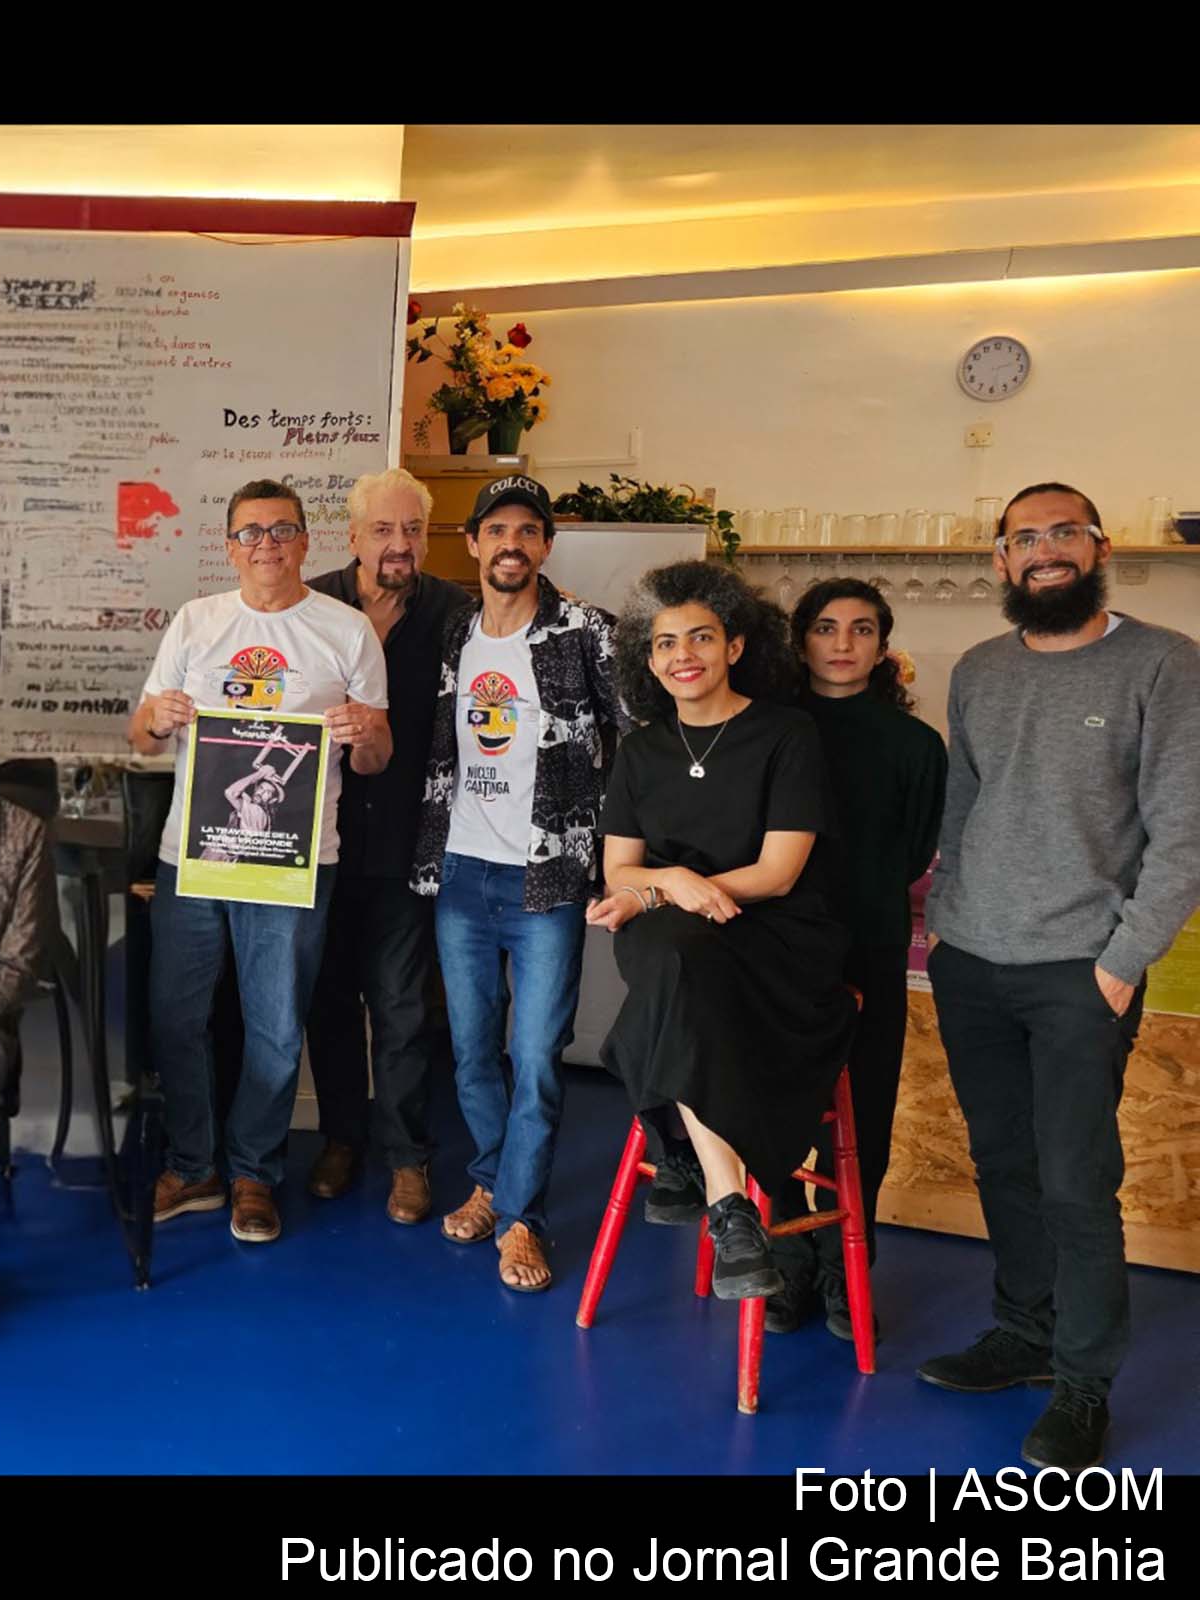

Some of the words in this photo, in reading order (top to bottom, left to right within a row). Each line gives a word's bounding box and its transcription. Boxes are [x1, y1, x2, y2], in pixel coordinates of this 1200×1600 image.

[223, 408, 261, 429] Des
[268, 409, 316, 428] temps
[282, 427, 339, 447] Pleins
[342, 426, 381, 445] feux
[490, 476, 539, 496] COLCCI
